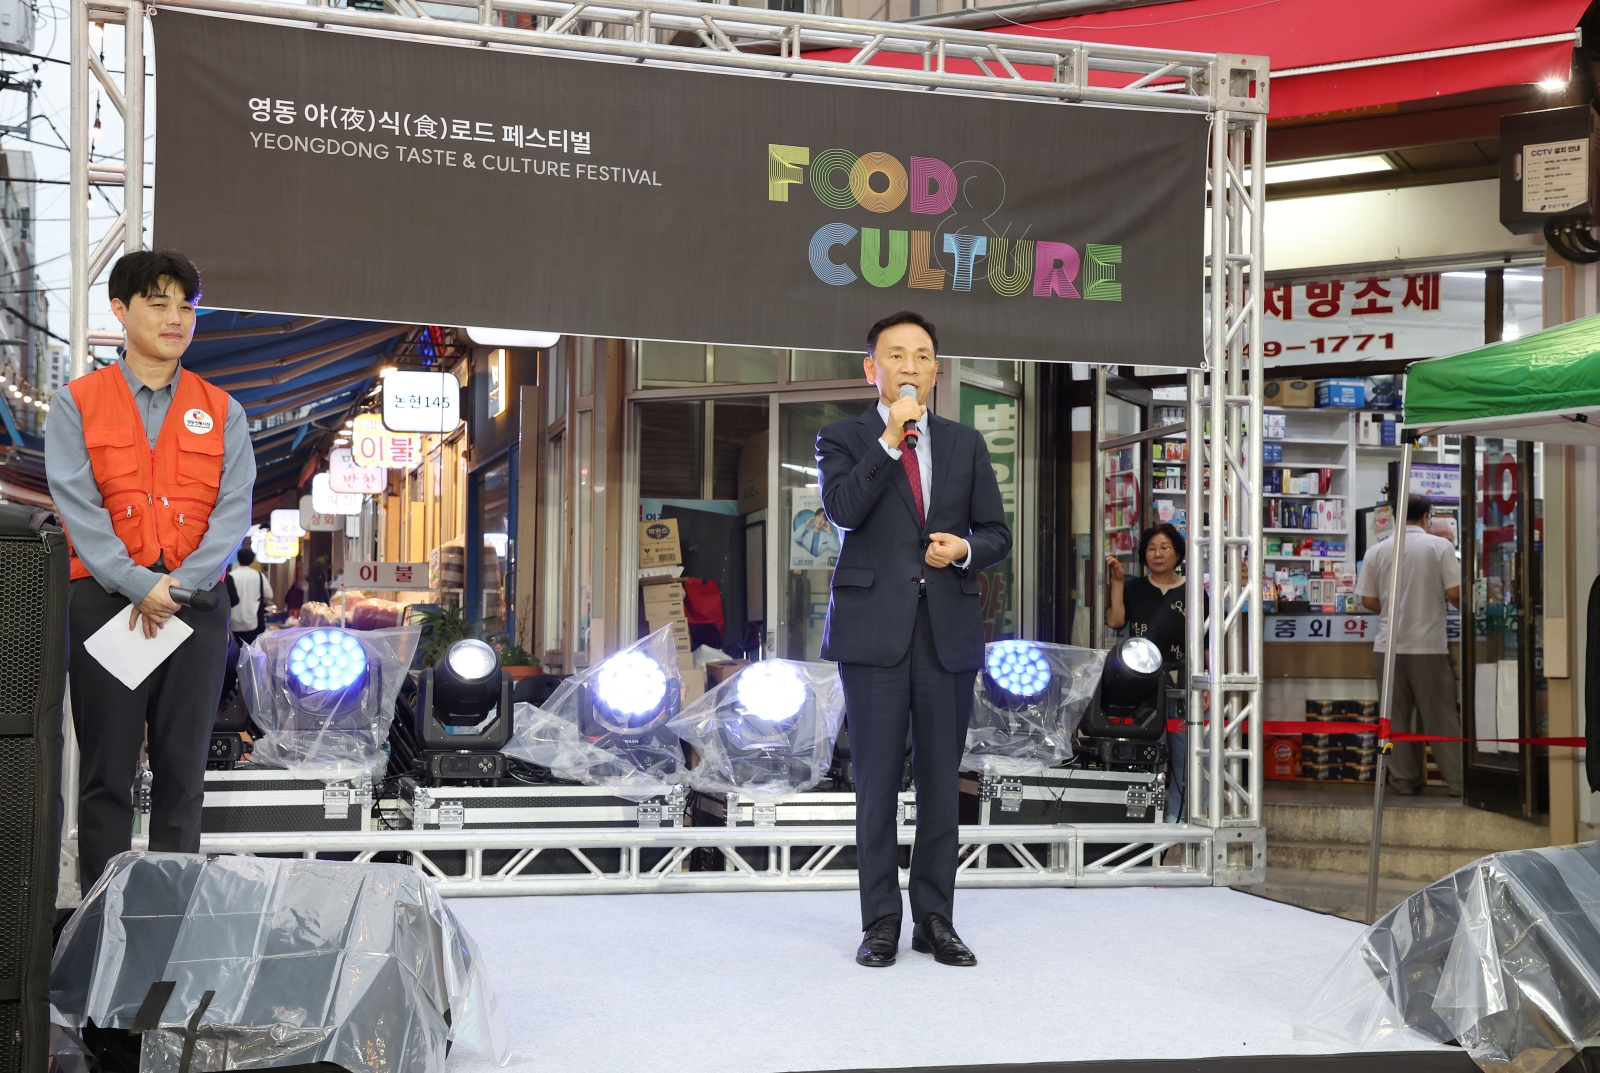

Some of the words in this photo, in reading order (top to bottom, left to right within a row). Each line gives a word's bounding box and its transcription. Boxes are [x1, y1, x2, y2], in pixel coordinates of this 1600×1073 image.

[248, 97, 297, 125] 영동
[304, 102, 496, 144] 야(夜)식(食)로드
[501, 124, 592, 155] 페스티벌
[1531, 148, 1552, 156] CCTV
[249, 131, 390, 160] YEONGDONG
[396, 145, 457, 168] TASTE
[462, 153, 477, 169] &
[482, 154, 571, 178] CULTURE
[576, 164, 662, 186] FESTIVAL
[768, 143, 958, 215] FOOD
[808, 222, 1123, 302] CULTURE
[393, 394, 451, 409] 논현145
[648, 527, 668, 535] 박카스
